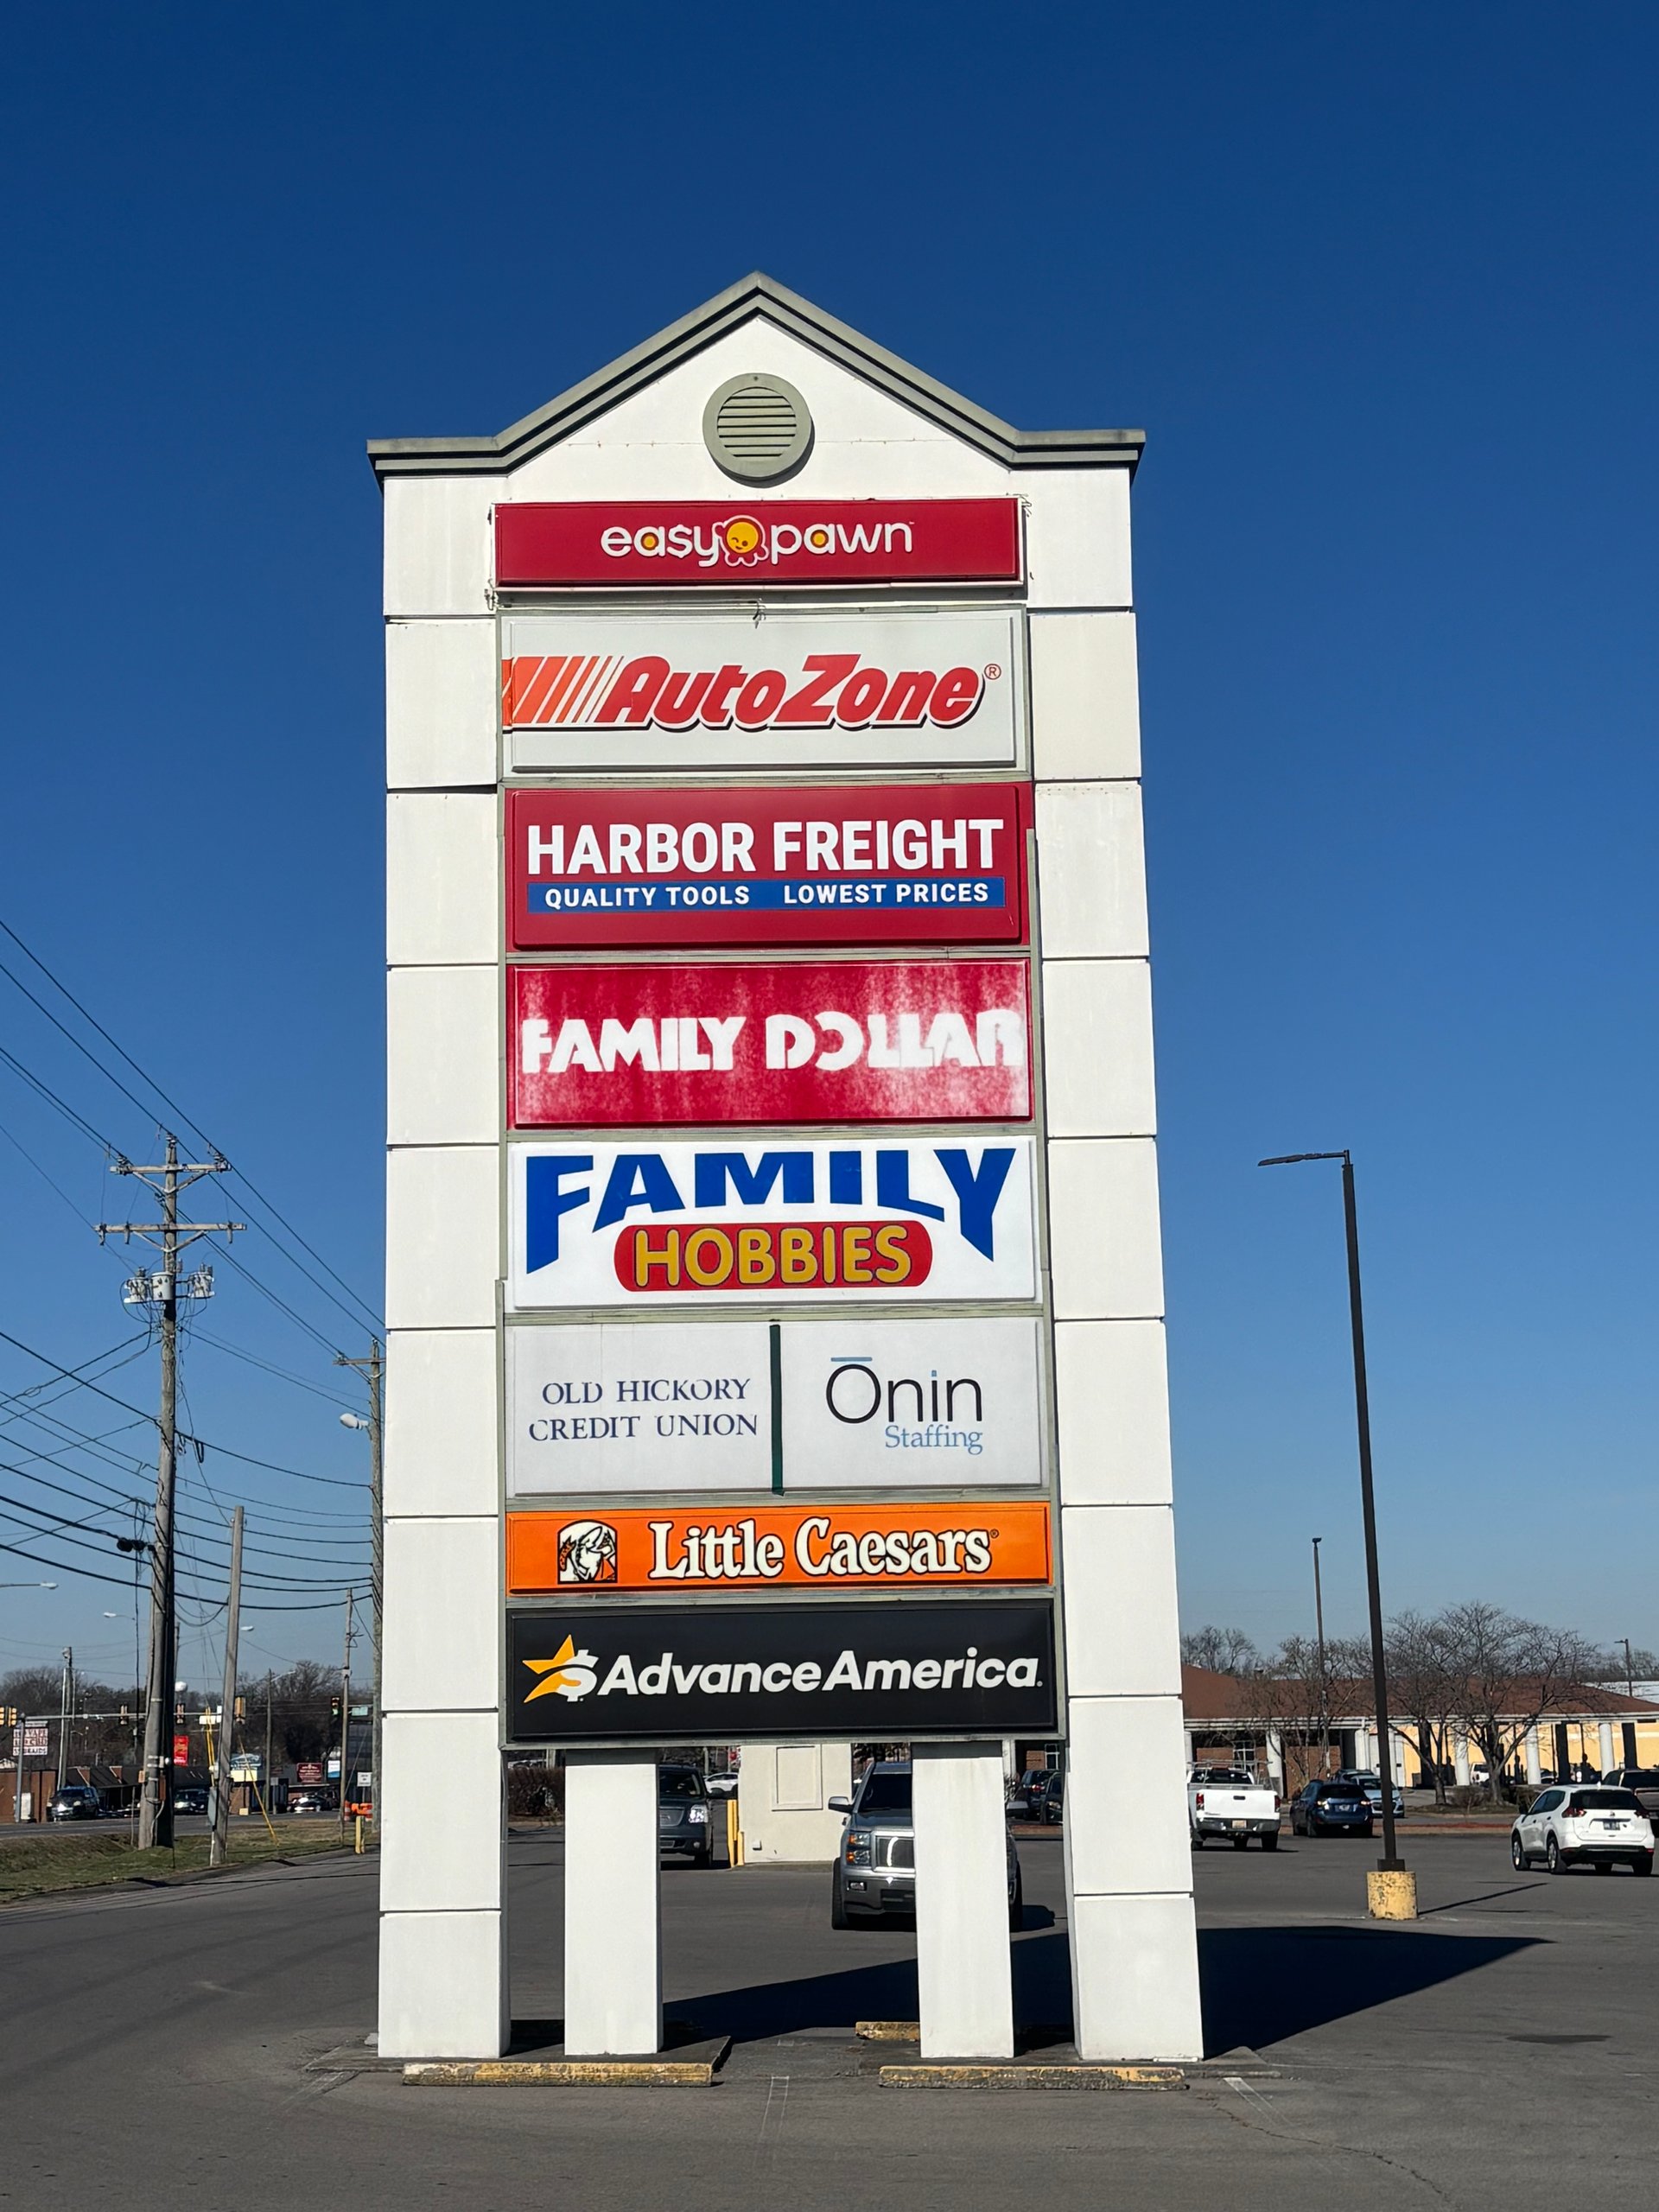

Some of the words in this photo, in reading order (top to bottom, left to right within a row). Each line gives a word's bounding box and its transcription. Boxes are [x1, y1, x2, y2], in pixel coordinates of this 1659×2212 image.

[771, 522, 912, 564] pawn
[528, 823, 756, 874] HARBOR
[773, 818, 1004, 871] FREIGHT
[545, 887, 656, 909] QUALITY
[665, 886, 749, 906] TOOLS
[784, 884, 887, 904] LOWEST
[896, 882, 988, 903] PRICES
[522, 1016, 746, 1073] FAMILY
[766, 1009, 1023, 1071] DOLLAR
[525, 1147, 1016, 1274] FAMILY
[634, 1225, 912, 1287] HOBBIES
[541, 1382, 603, 1406] OLD
[616, 1377, 751, 1402] HICKORY
[528, 1414, 641, 1442] CREDIT
[657, 1412, 758, 1438] UNION
[884, 1425, 983, 1455] Staffing
[648, 1519, 785, 1580] Little
[795, 1516, 992, 1576] Caesars
